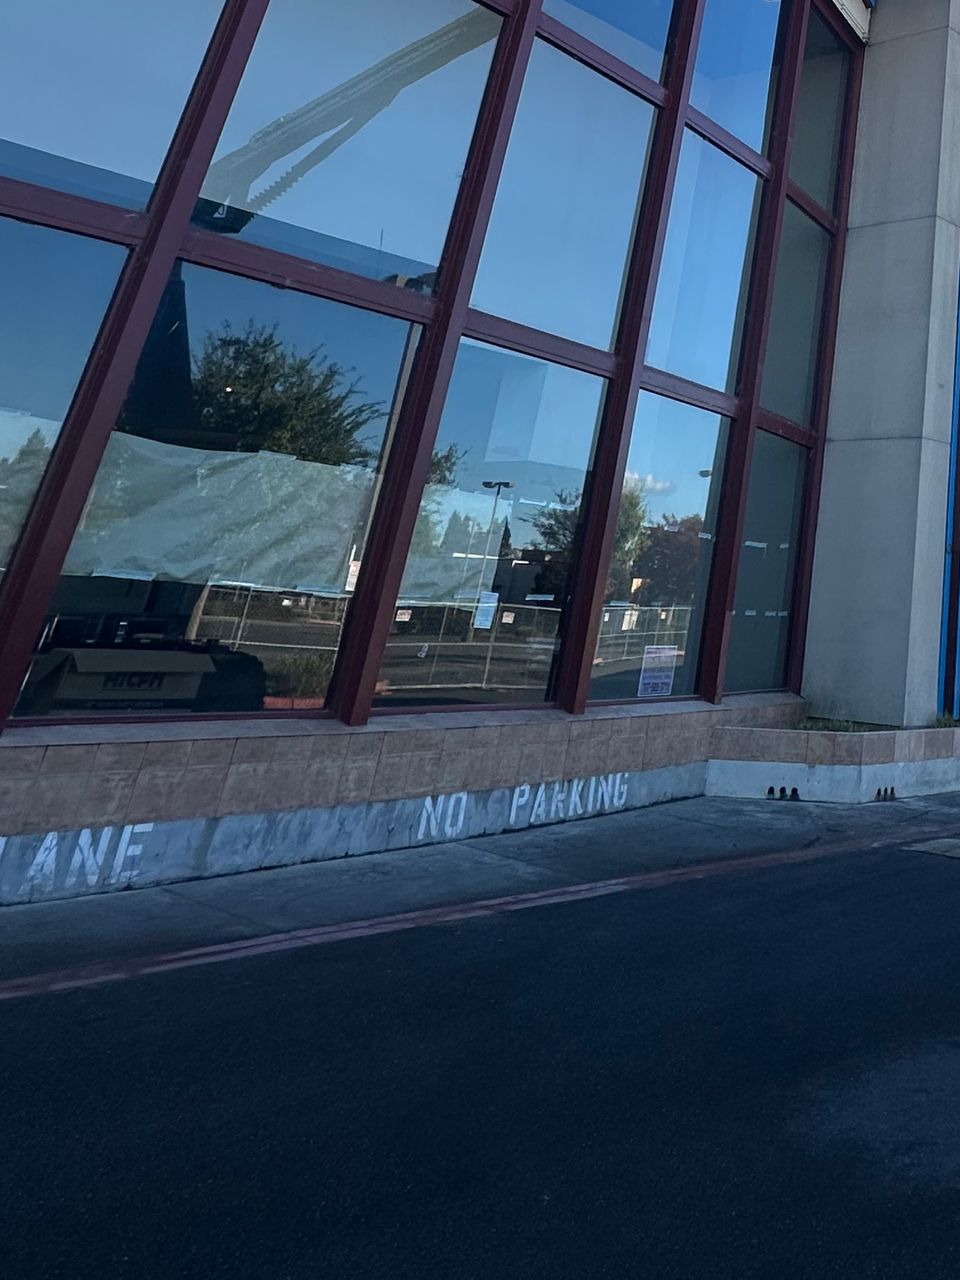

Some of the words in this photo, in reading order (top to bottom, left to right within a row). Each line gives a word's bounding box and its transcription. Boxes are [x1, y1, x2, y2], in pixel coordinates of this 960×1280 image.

[0, 822, 154, 898] ANE
[417, 792, 468, 839] NO
[509, 772, 629, 824] PARKING
